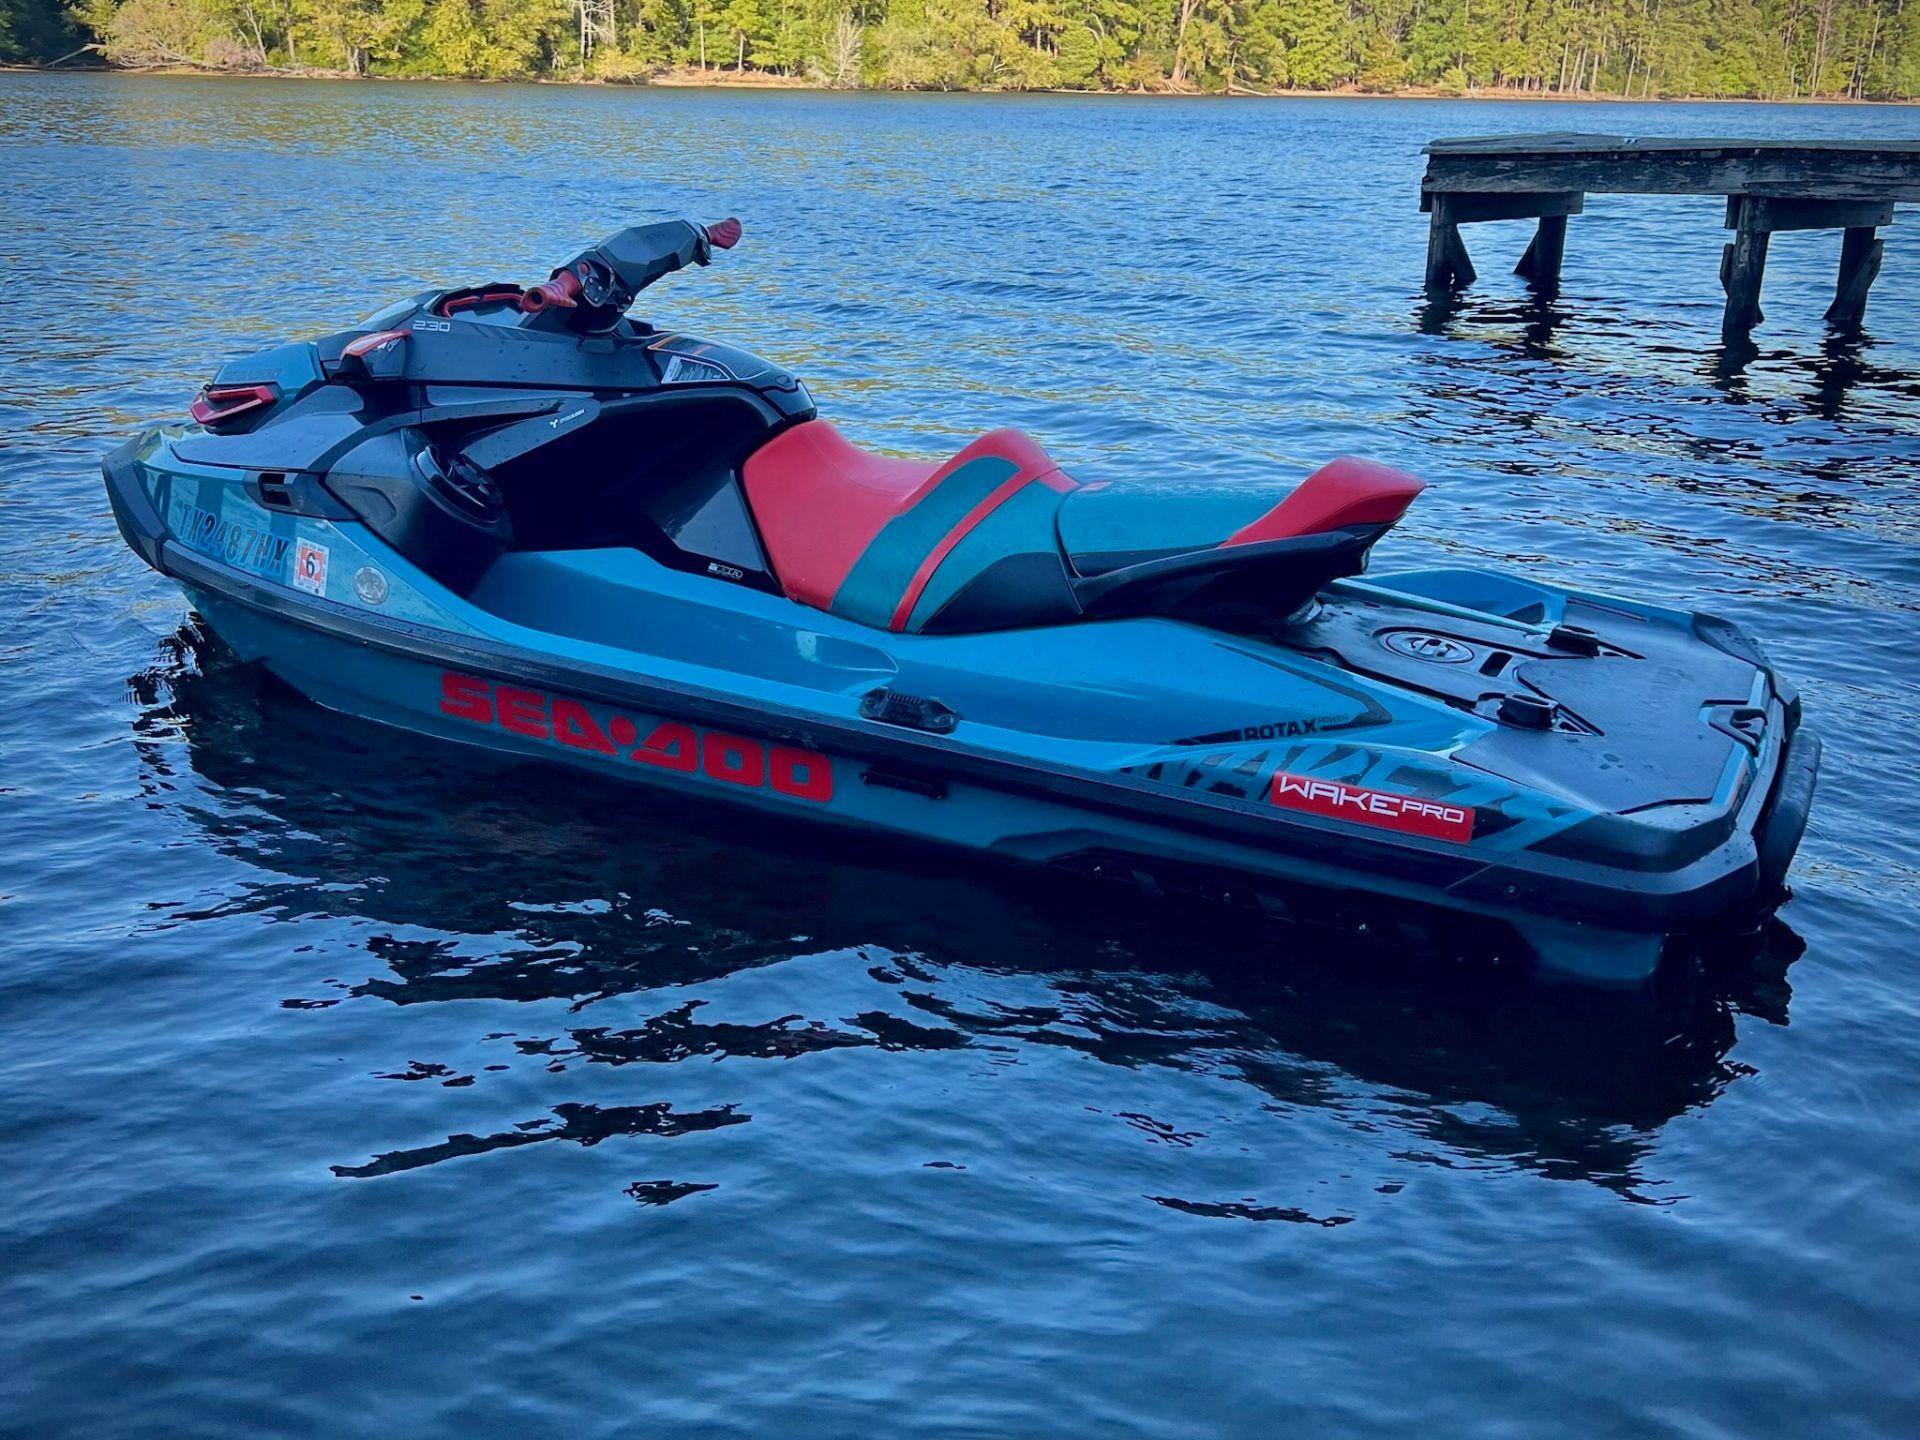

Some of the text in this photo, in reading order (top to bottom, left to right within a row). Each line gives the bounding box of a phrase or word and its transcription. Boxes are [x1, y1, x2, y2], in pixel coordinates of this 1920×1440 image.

[413, 320, 451, 332] 230
[306, 552, 317, 579] 6
[1244, 714, 1350, 741] ROTAX POWER
[1280, 776, 1465, 824] WAKE PRO
